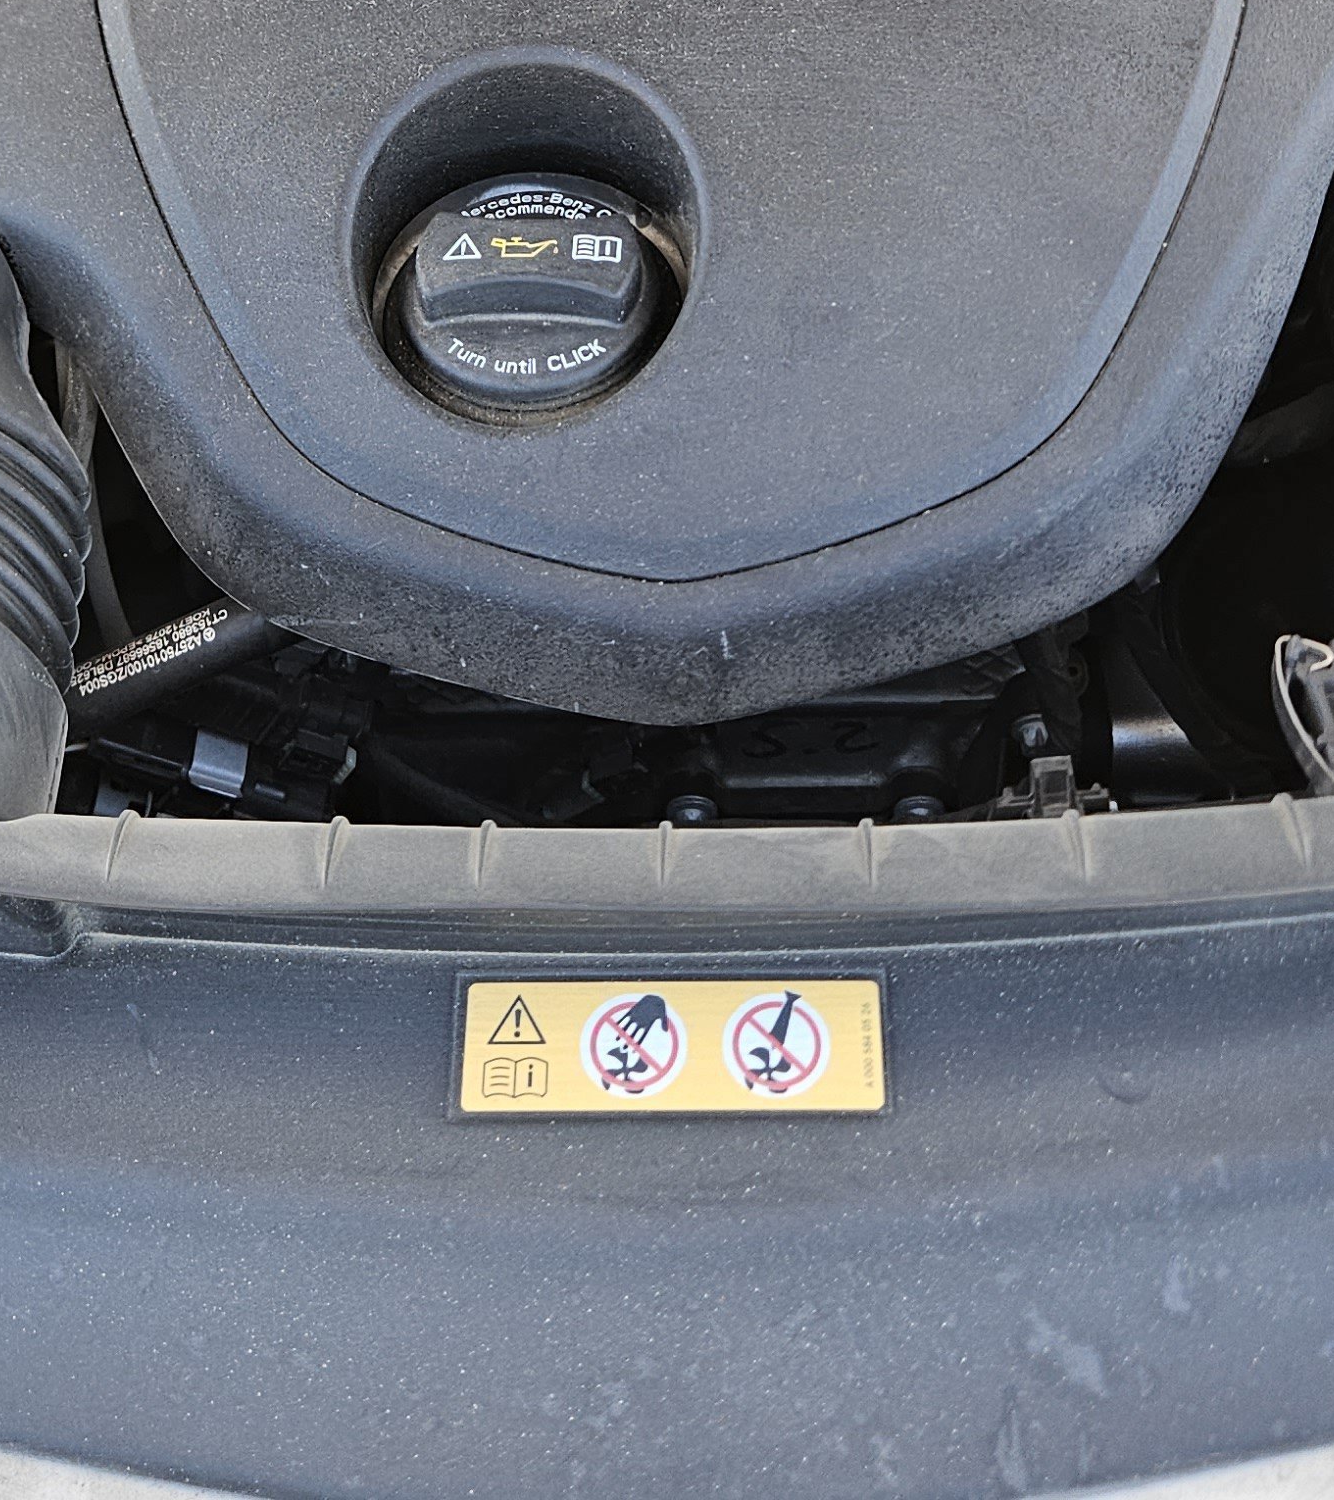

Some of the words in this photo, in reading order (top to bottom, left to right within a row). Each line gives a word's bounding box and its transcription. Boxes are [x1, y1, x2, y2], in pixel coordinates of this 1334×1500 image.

[447, 337, 487, 369] Turn
[494, 357, 537, 375] until
[546, 338, 607, 372] CLICK
